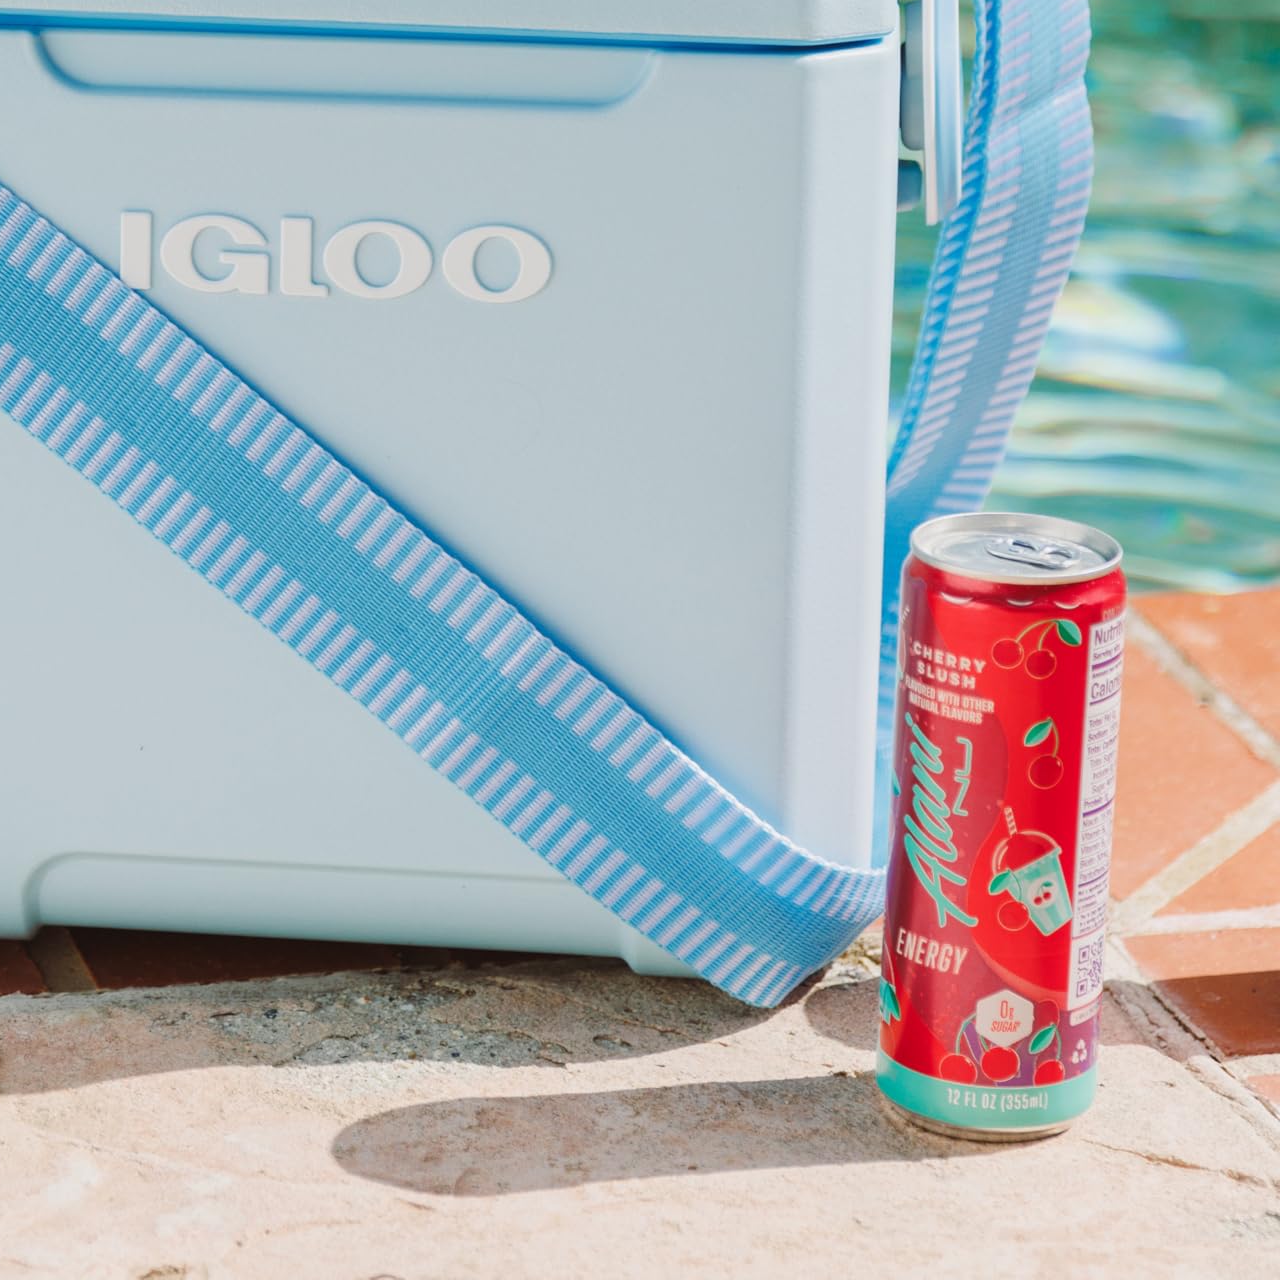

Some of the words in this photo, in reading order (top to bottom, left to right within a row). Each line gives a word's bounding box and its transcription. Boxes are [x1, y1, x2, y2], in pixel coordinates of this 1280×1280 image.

[120, 211, 553, 303] IGLOO
[912, 640, 987, 674] CHERRY
[917, 659, 976, 690] SLUSH
[937, 689, 960, 707] WITH
[962, 694, 995, 713] OTHER
[941, 703, 983, 725] FLAVORS
[904, 711, 979, 928] Alani
[896, 926, 969, 975] ENERGY
[947, 1087, 960, 1106] 12
[964, 1090, 977, 1109] FL
[982, 1093, 997, 1110] OZ
